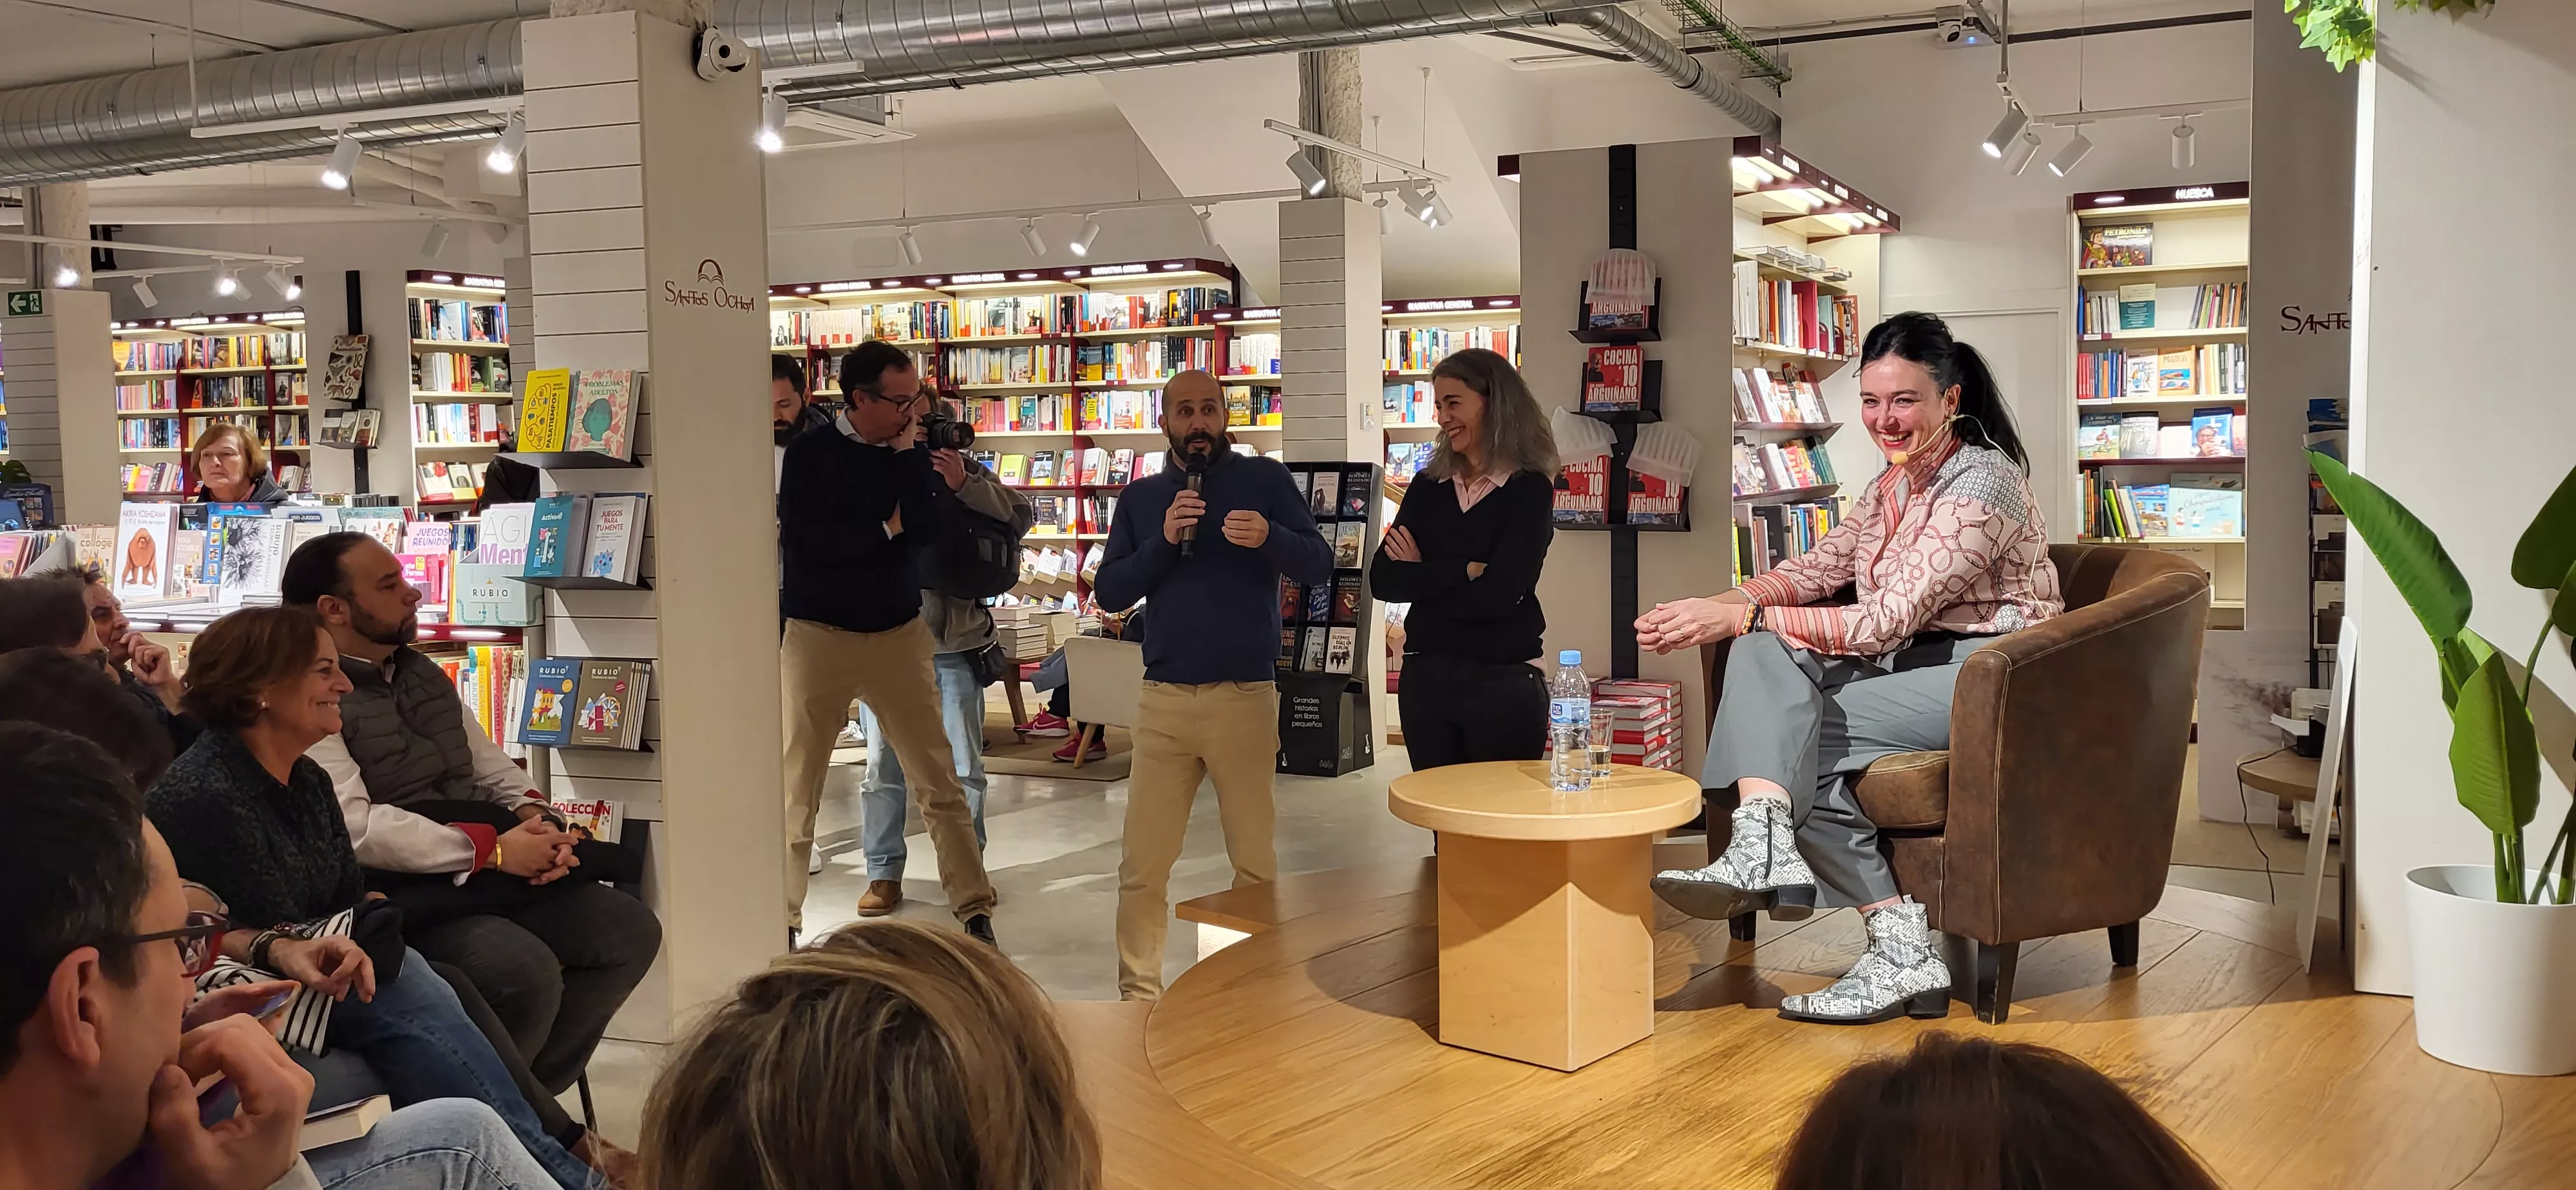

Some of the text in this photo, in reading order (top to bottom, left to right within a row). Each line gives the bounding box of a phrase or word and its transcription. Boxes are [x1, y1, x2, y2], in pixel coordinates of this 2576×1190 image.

[2175, 187, 2215, 200] HUESCA
[2105, 227, 2148, 236] PETRONILA
[1092, 264, 1148, 276] NARRATIVA GENERAL
[952, 272, 1006, 283] NARRATIVA GENERAL
[1407, 299, 1474, 311] NARRATIVA GENERAL
[1243, 309, 1276, 319] NARRATIVA
[2280, 306, 2351, 335] SANTO
[1604, 348, 1638, 365] COCINA
[1623, 364, 1638, 386] 10
[1587, 386, 1638, 403] ARGUIÑANO
[546, 392, 557, 449] PASATIEMPOS
[1569, 457, 1604, 473] COCINA
[1589, 473, 1604, 496] 10
[1552, 494, 1603, 511] ARGUIÑANO
[1629, 496, 1680, 513] ARGUIÑANO
[417, 527, 449, 536] JUEGOS
[273, 524, 282, 556] DIBUJO
[412, 537, 449, 547] REUNIDO
[473, 589, 509, 597] RUBIO
[539, 666, 565, 675] RUBIO
[591, 667, 618, 675] RUBIO
[1294, 704, 1319, 712] historias
